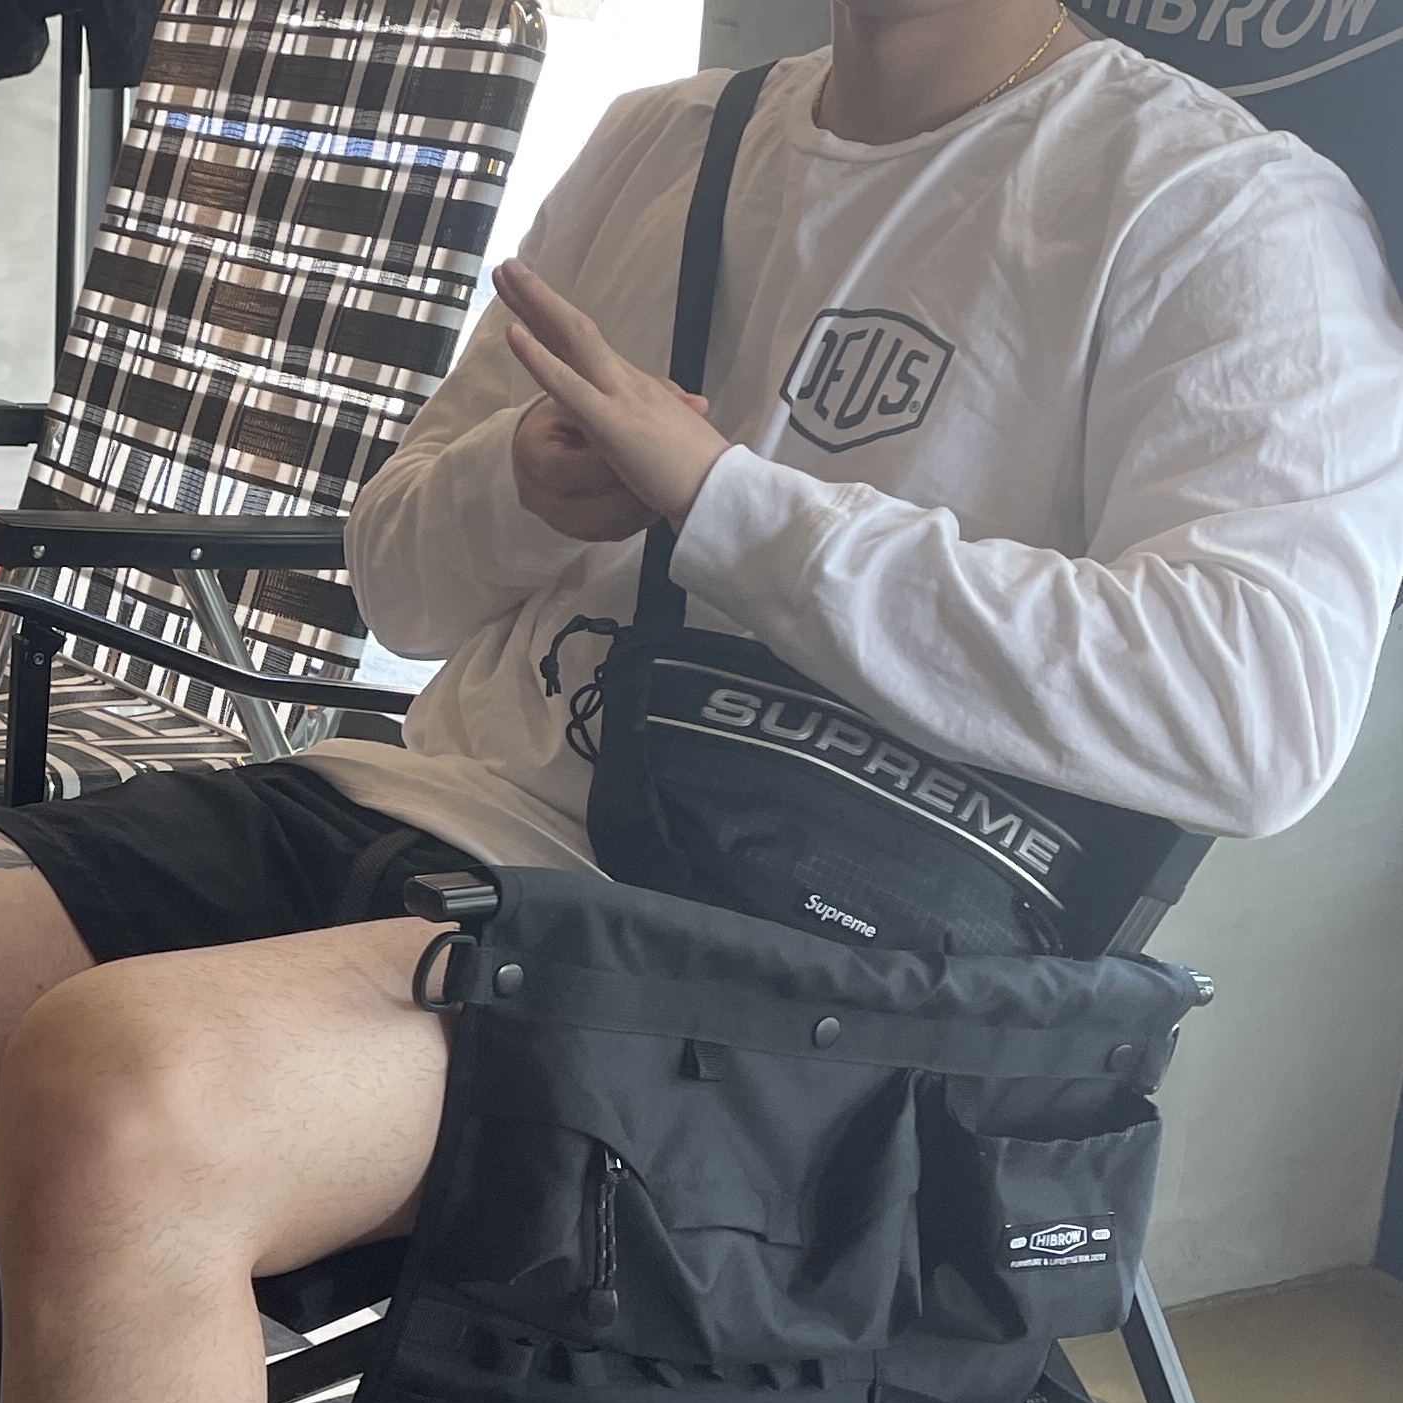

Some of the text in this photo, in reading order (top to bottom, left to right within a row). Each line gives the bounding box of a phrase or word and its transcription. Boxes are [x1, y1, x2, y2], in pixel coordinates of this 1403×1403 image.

[701, 688, 1061, 875] SUPREME
[804, 894, 877, 938] Supreme
[1036, 1230, 1082, 1247] HIBROW
